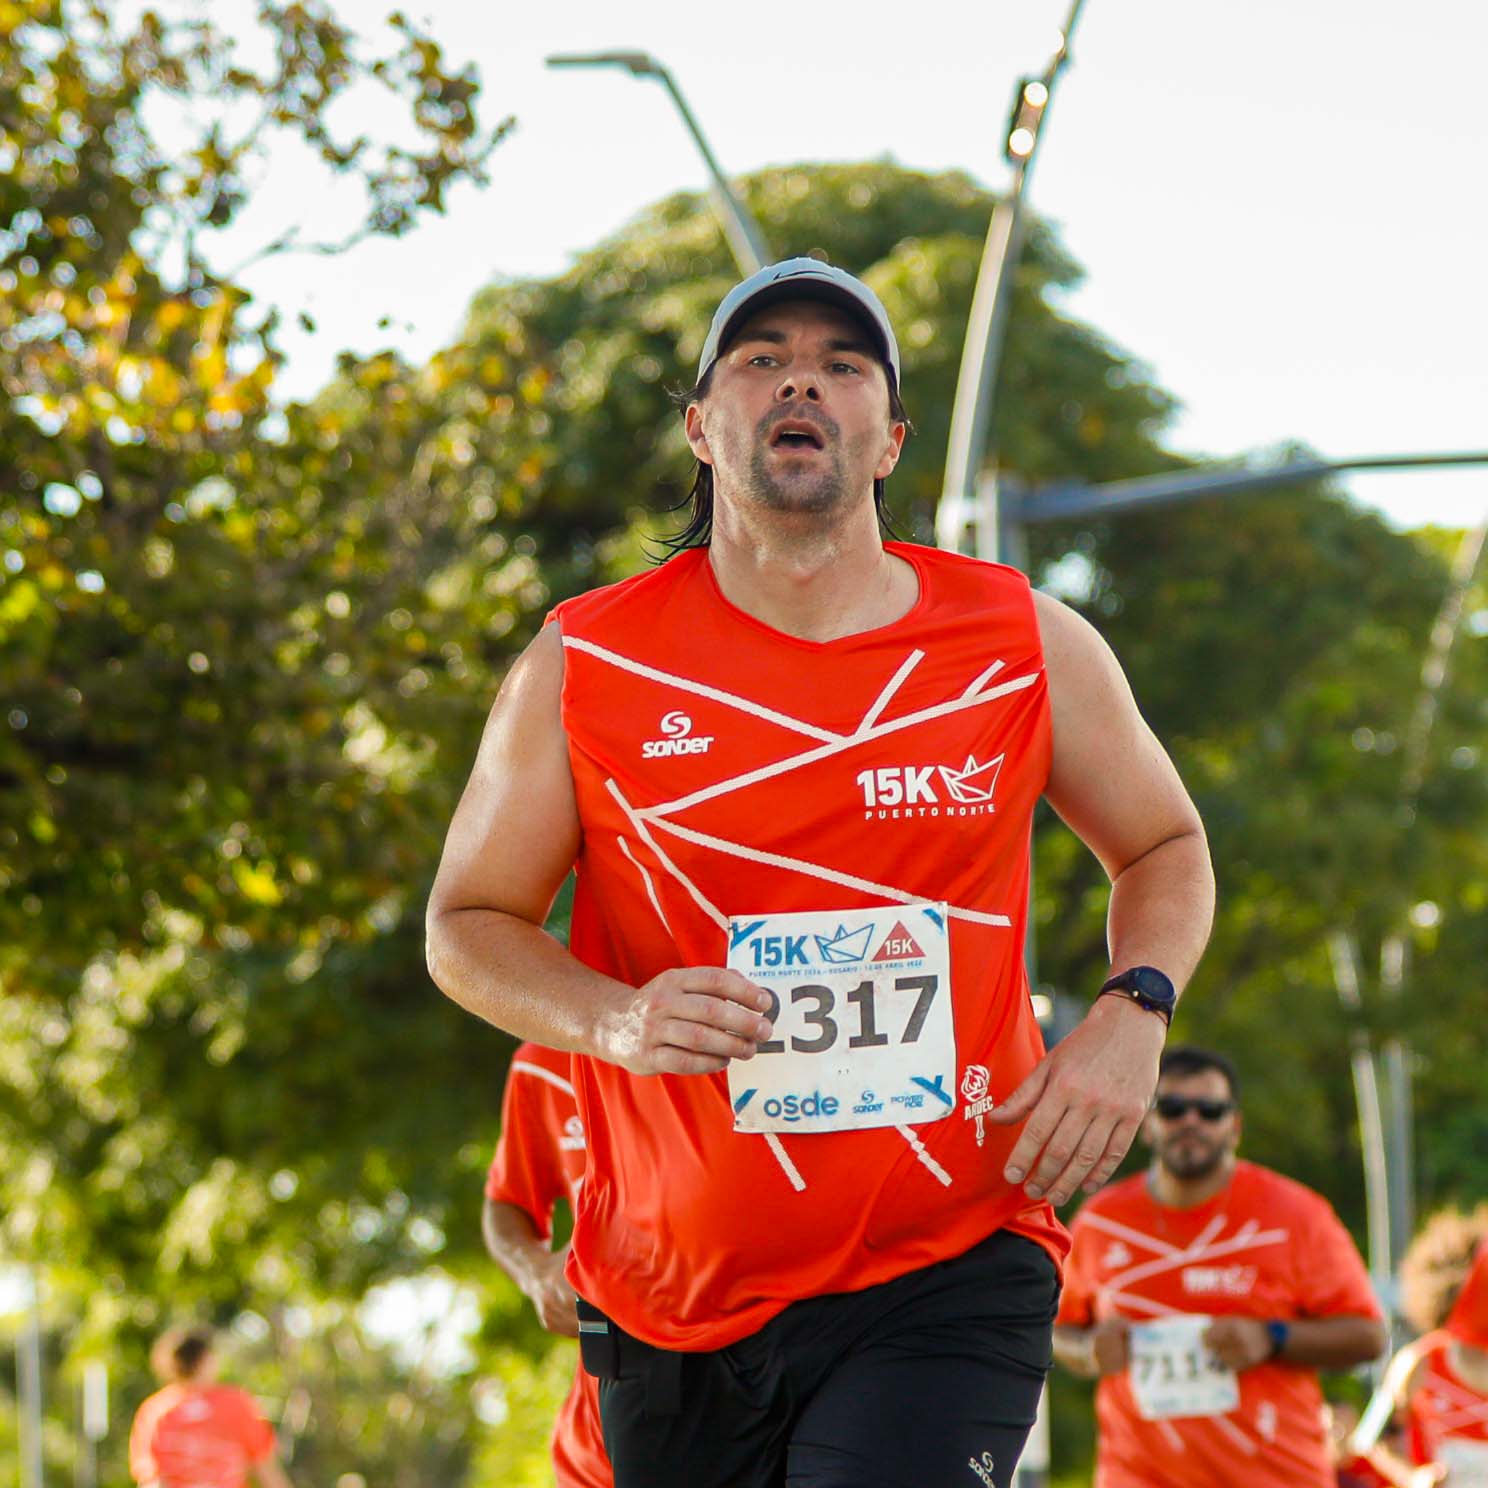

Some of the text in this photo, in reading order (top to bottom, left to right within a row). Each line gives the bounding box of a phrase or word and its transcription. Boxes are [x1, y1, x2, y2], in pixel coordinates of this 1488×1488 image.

[856, 766, 939, 807] 15K
[865, 803, 995, 820] PUERTO NORTE
[749, 934, 810, 967] 15K
[884, 938, 914, 956] 15K
